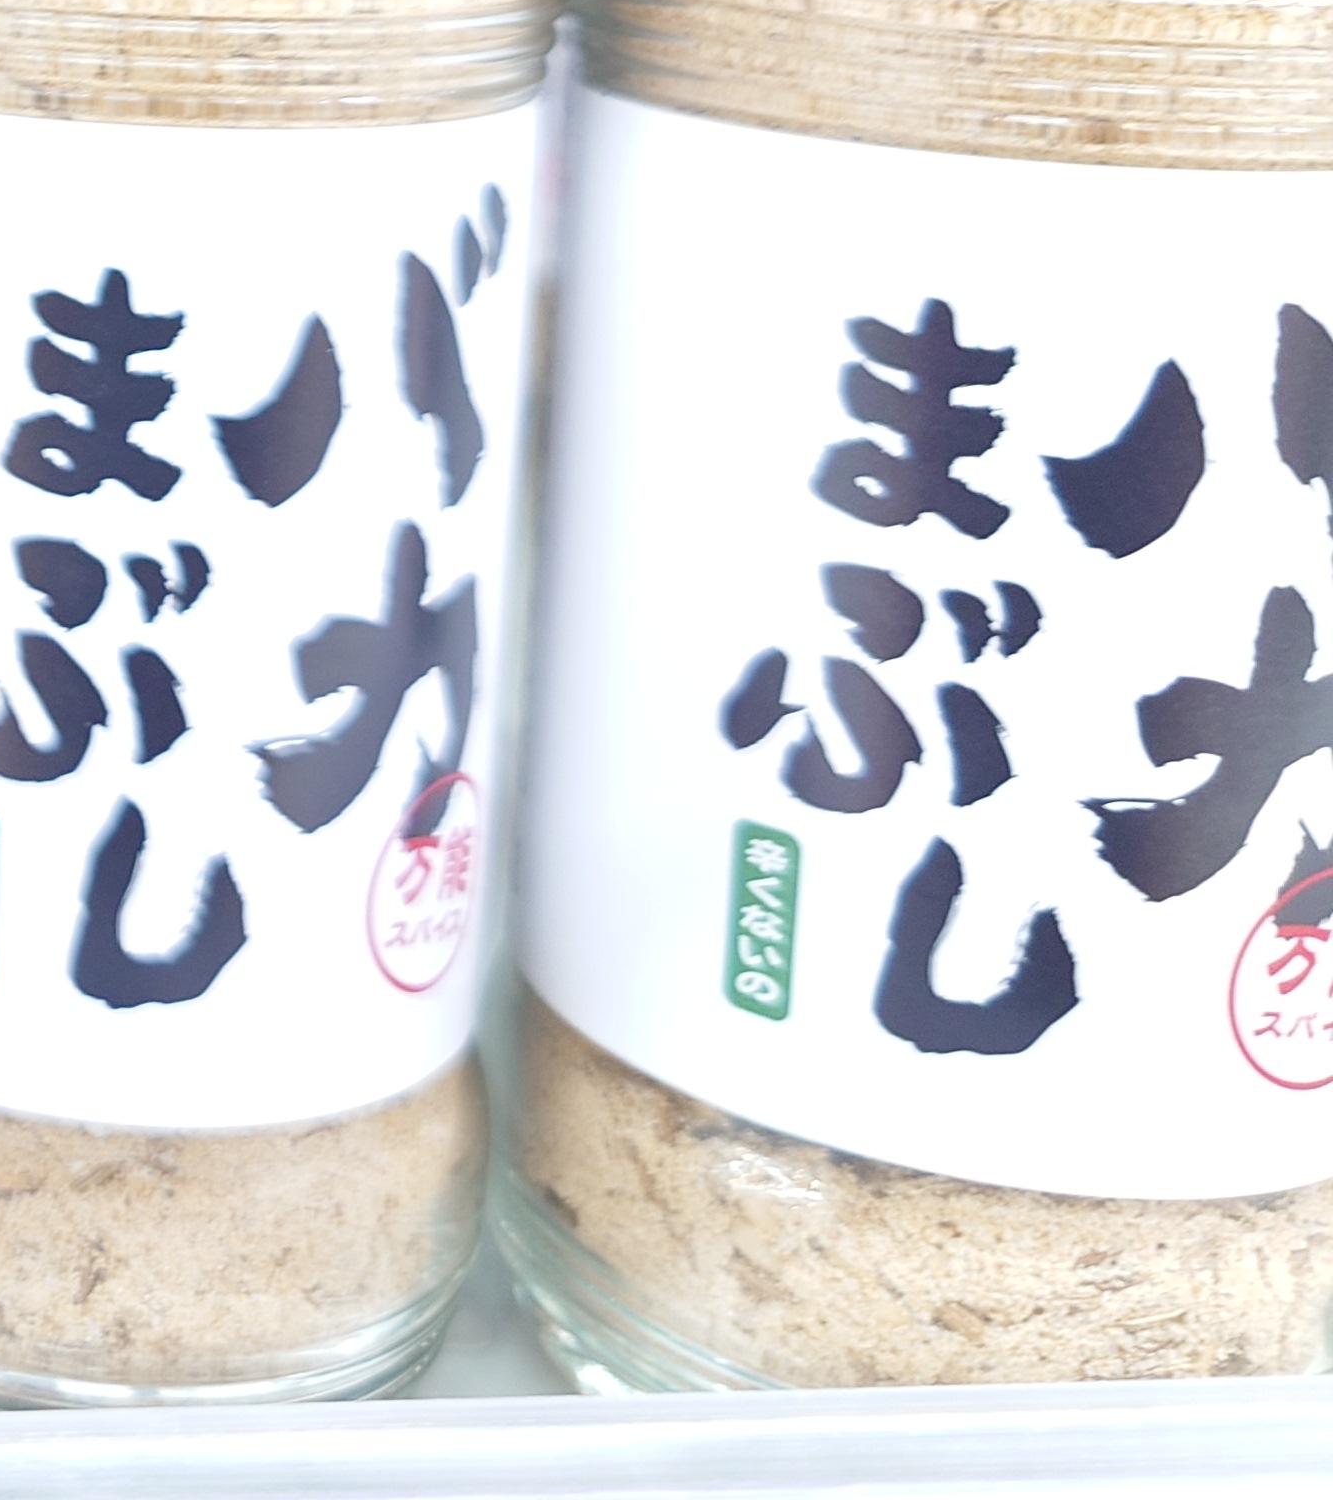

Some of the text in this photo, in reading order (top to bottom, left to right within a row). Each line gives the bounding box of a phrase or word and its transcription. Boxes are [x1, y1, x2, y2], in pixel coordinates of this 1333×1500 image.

[718, 296, 1082, 1056] まぶし
[733, 836, 789, 1003] 辛くないの
[1266, 923, 1333, 996] 万
